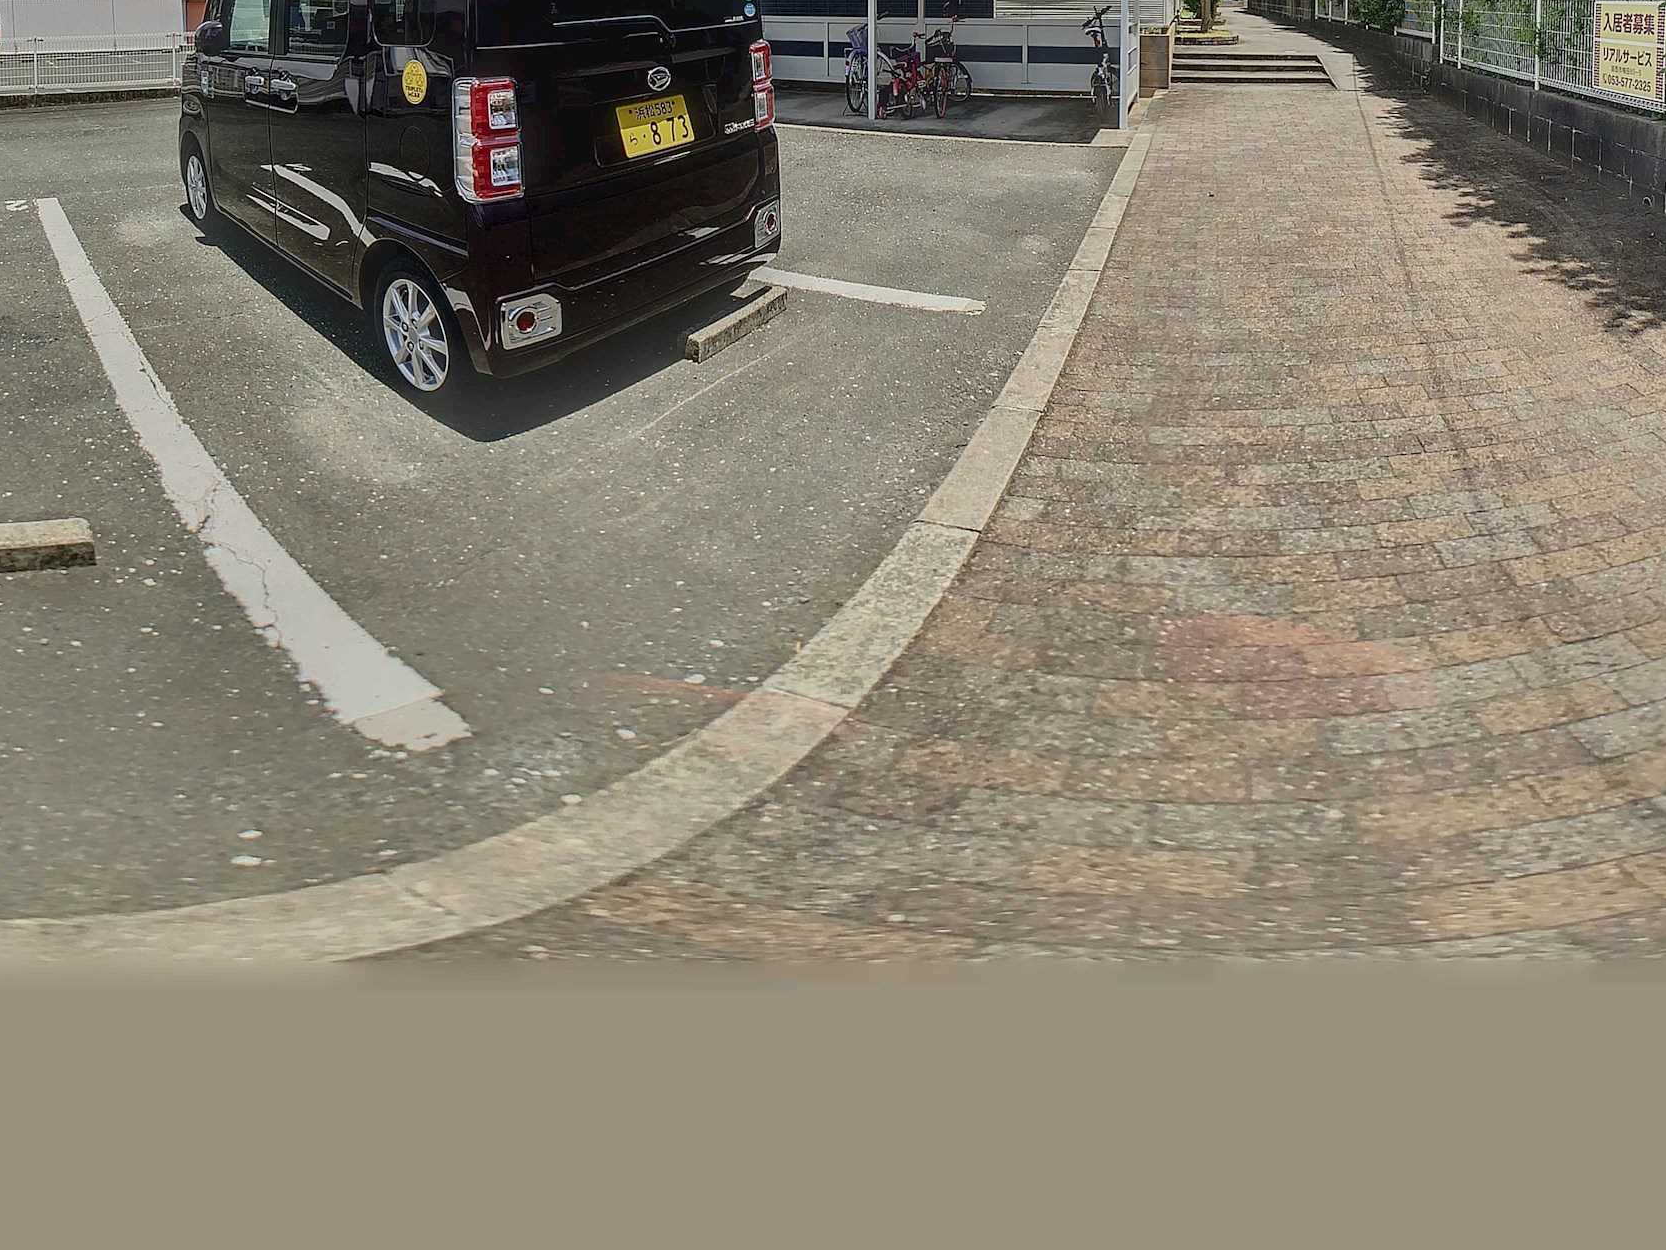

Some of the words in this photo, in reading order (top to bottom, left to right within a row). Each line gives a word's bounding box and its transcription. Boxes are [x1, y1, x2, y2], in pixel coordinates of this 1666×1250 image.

[1603, 12, 1655, 35] 入居者募集
[1603, 46, 1653, 67] リアルサービス
[1607, 72, 1652, 93] 053-577-2325
